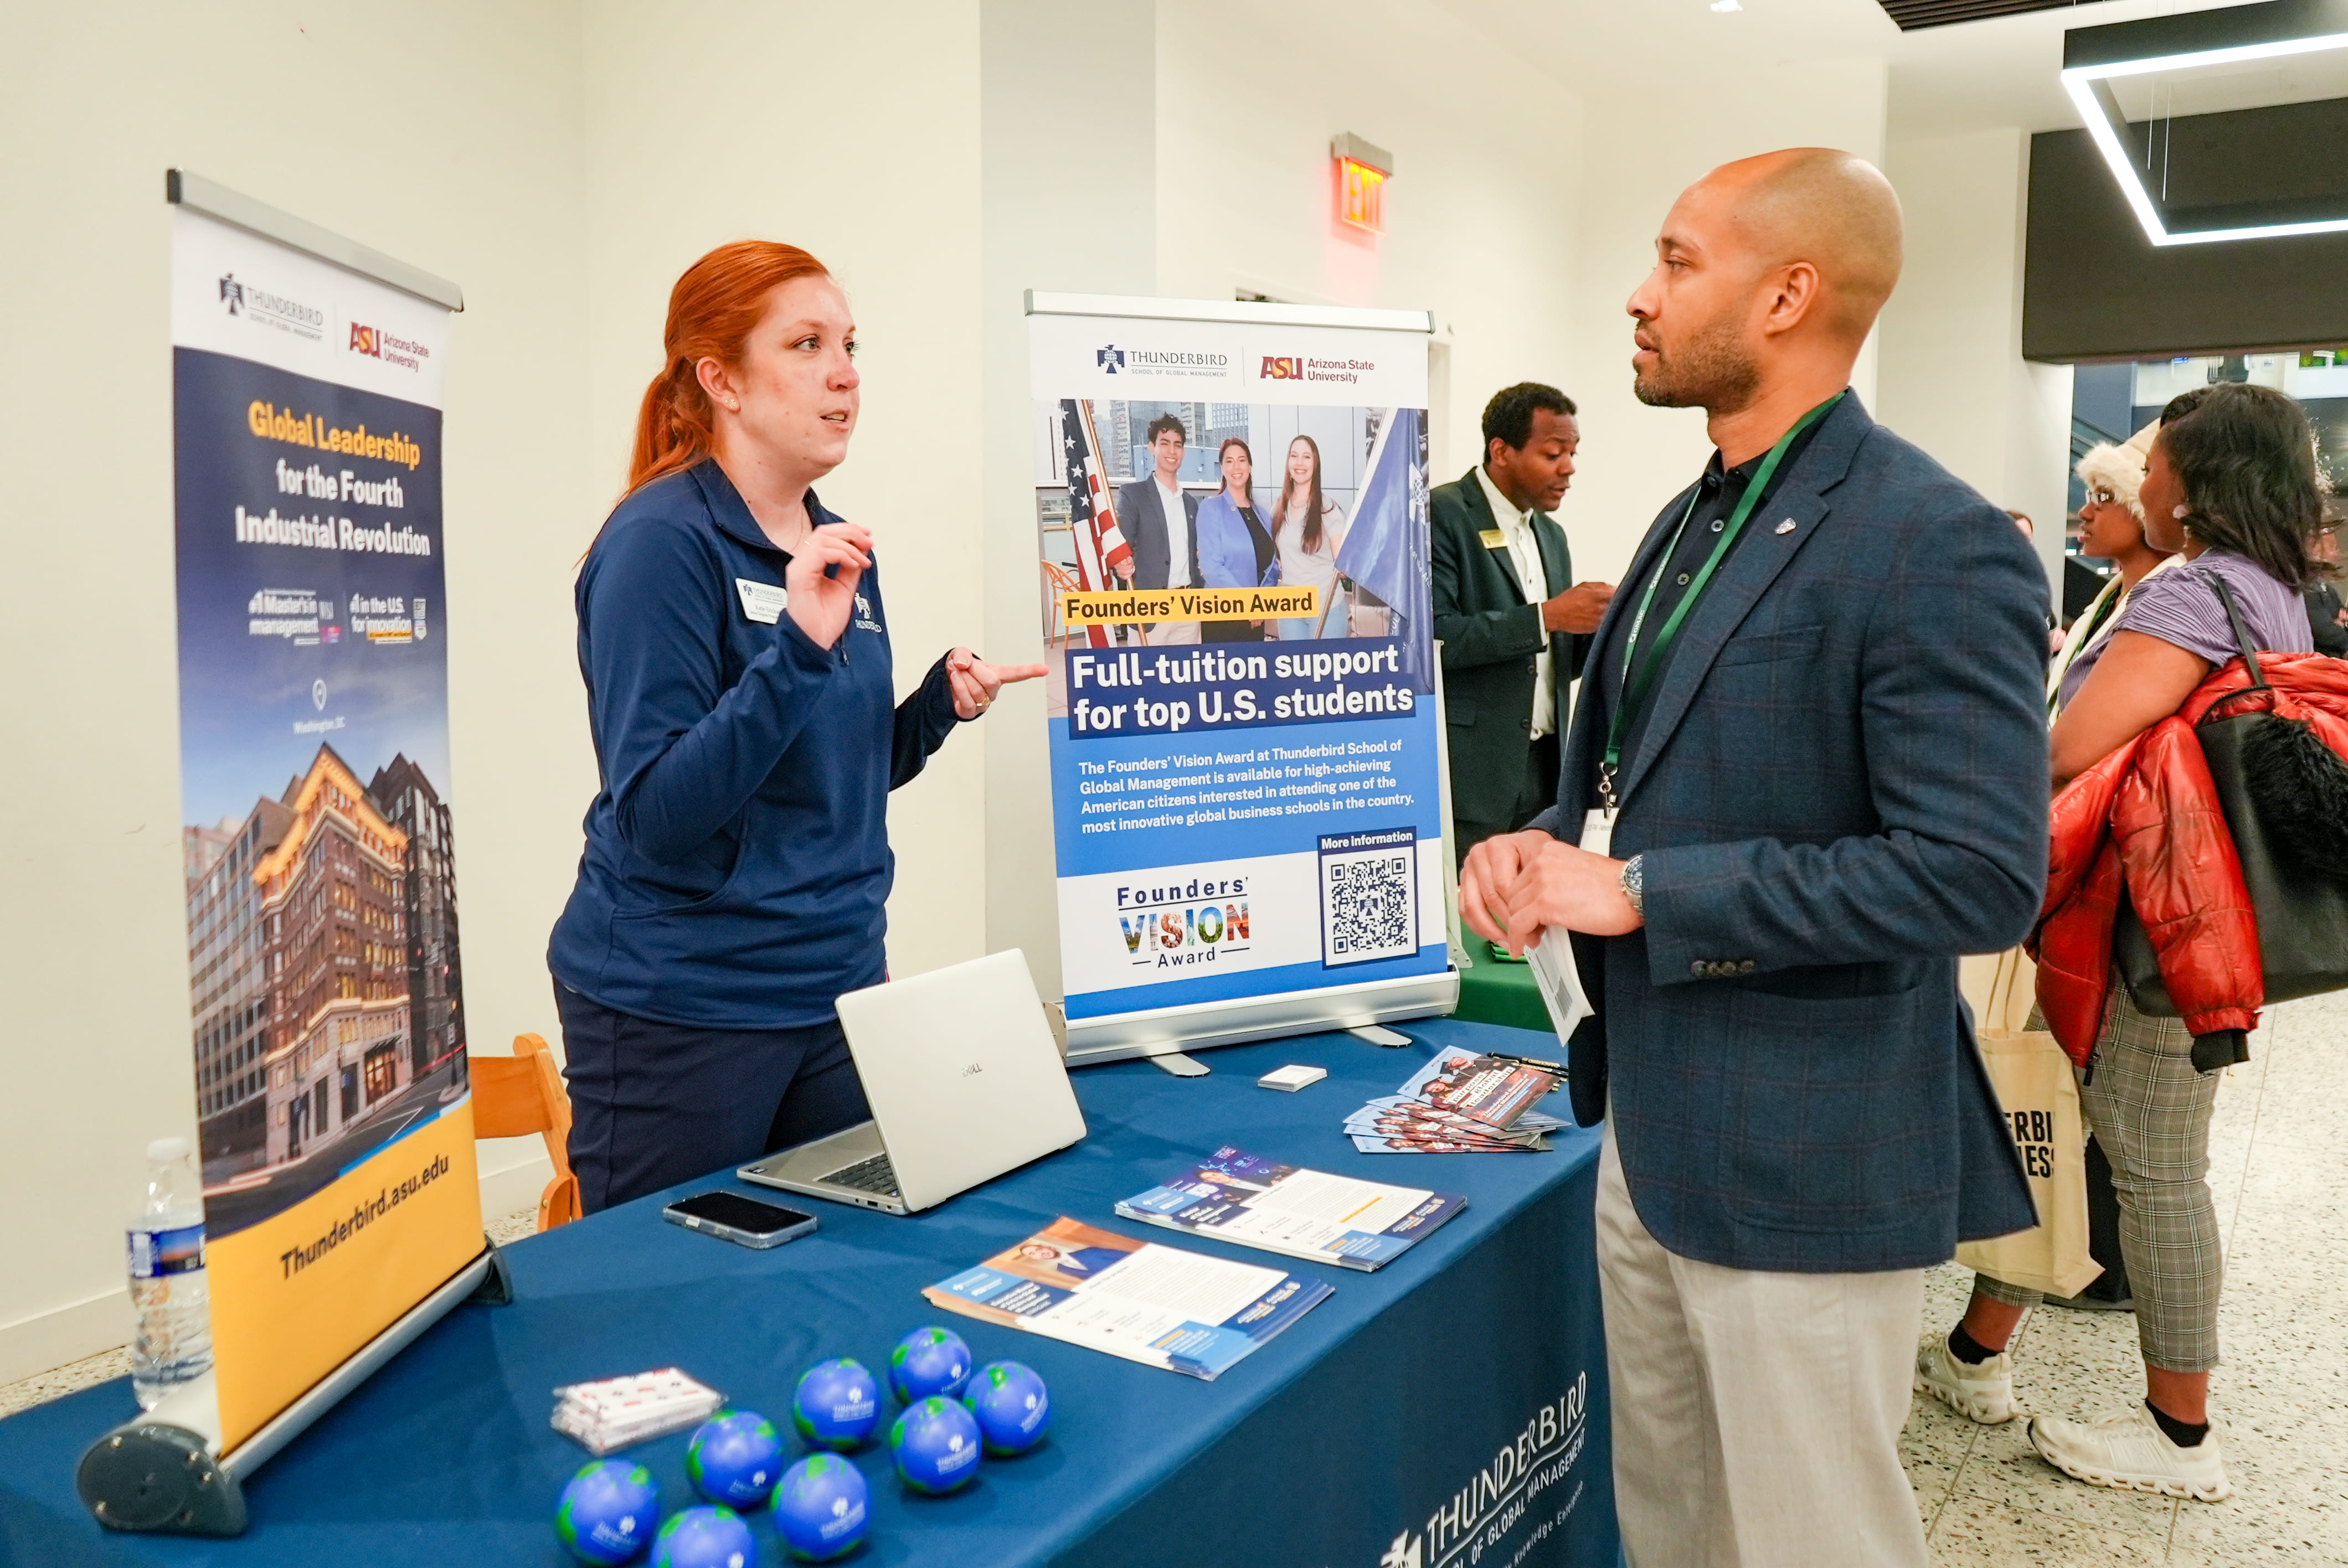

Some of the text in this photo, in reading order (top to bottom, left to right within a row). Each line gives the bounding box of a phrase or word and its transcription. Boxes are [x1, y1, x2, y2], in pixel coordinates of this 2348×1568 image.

[1350, 162, 1384, 227] EXIT
[248, 287, 323, 326] THUNDERBIRD
[349, 321, 382, 359] ASU
[384, 332, 430, 358] Arizona State
[1130, 350, 1227, 366] THUNDERBIRD
[385, 349, 419, 373] University
[1260, 356, 1304, 380] ASU
[1307, 358, 1374, 370] Arizona State
[1307, 371, 1358, 384] University
[248, 400, 420, 471] Global Leadership
[277, 458, 403, 508] for the Fourth
[235, 506, 430, 555] Industrial Revolution
[360, 595, 369, 613] in
[370, 596, 386, 613] the
[387, 596, 405, 613] U.S.
[1067, 592, 1312, 619] Founders’ Vision Award
[249, 617, 319, 638] management
[352, 616, 366, 633] for
[1073, 644, 1399, 689] Full-tuition support
[1074, 683, 1414, 731] for top U.S. students
[1079, 740, 1402, 775] The Founders’ Vision Award at Thunderbird School of
[1080, 759, 1391, 795] Global Management is available for high-achieving
[1082, 776, 1396, 814] American citizens interested in attending one of the
[1082, 793, 1414, 834] most innovative global business schools in the country.
[1321, 832, 1413, 850] More information
[1118, 877, 1248, 906] Founders’
[1119, 903, 1249, 954] VISION
[1158, 947, 1215, 968] Award
[1453, 1074, 1484, 1102] purpose
[1470, 1069, 1512, 1106] leadership
[1475, 1071, 1499, 1094] global
[280, 1154, 449, 1280] Thunderbird.asu.edu
[1428, 1371, 1587, 1564] THUNDERBIRD
[1471, 1427, 1585, 1565] OF GLOBAL MANAGEMENT
[1514, 1520, 1553, 1565] Knowledge
